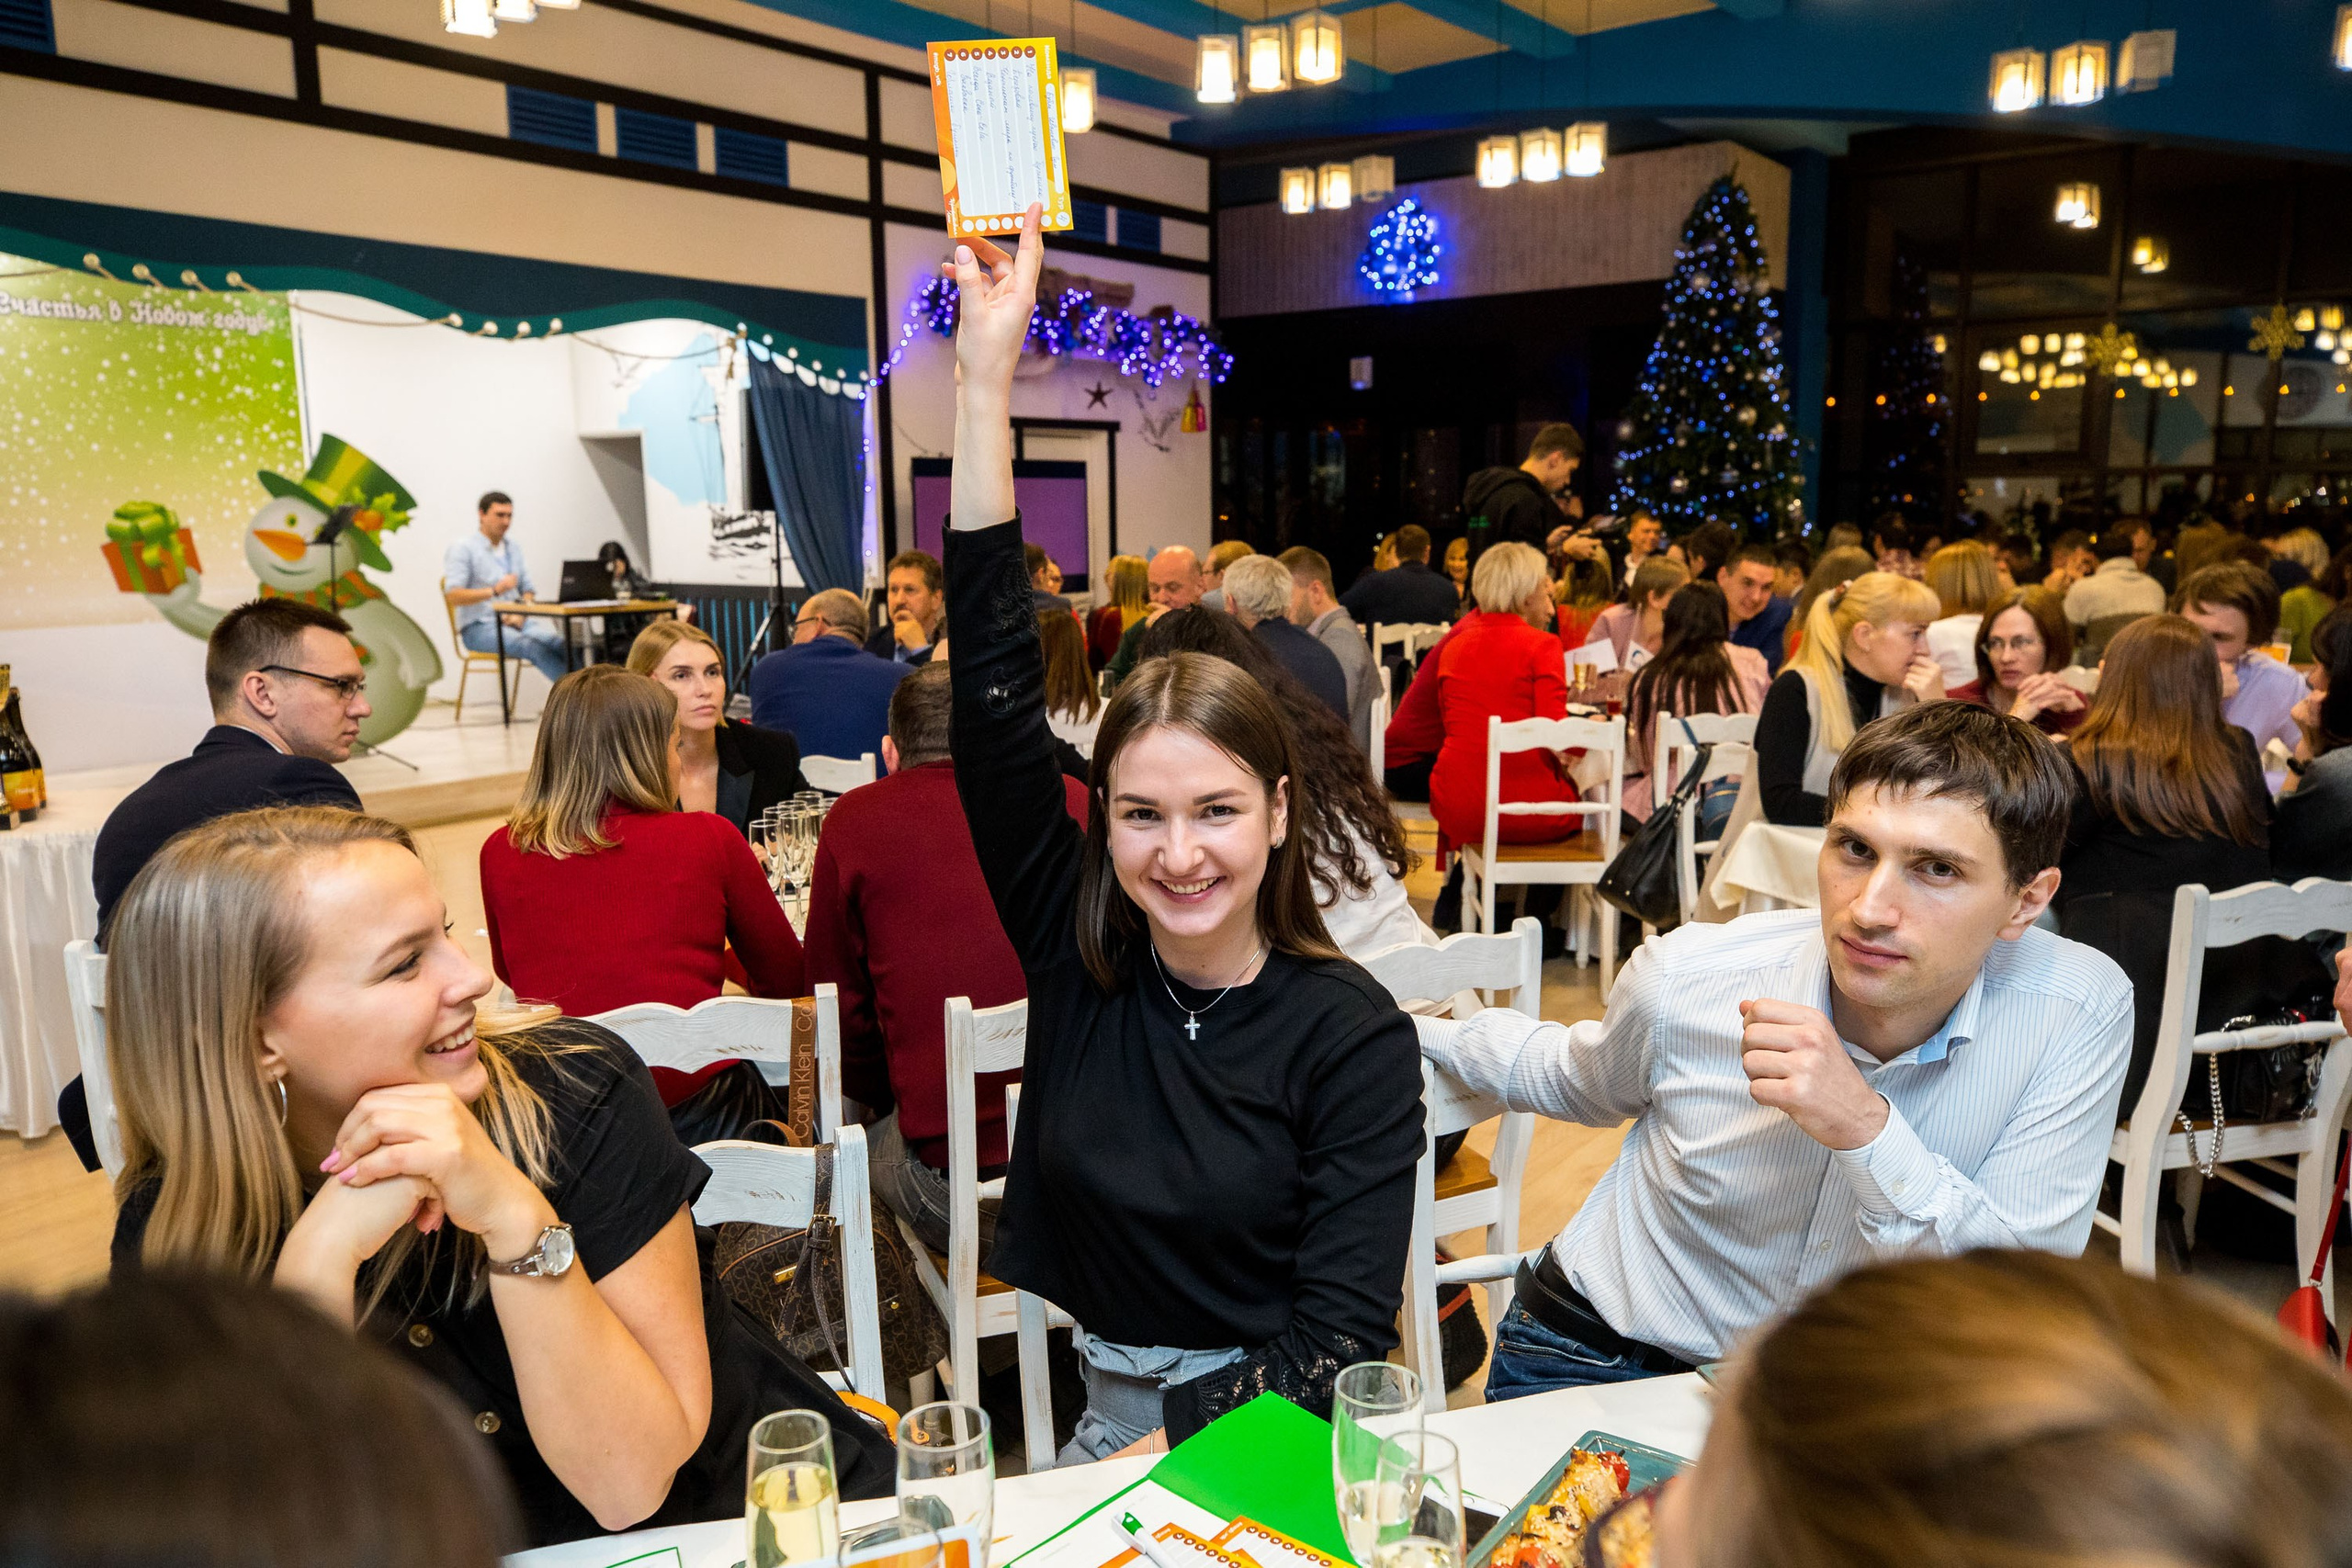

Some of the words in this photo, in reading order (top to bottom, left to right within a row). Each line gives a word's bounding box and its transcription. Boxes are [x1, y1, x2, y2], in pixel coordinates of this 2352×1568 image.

[1044, 44, 1053, 80] Команда
[0, 290, 103, 321] Счастья
[107, 299, 122, 321] в
[129, 299, 208, 327] Новом
[794, 1043, 812, 1083] Klein
[793, 1086, 810, 1139] Calvin
